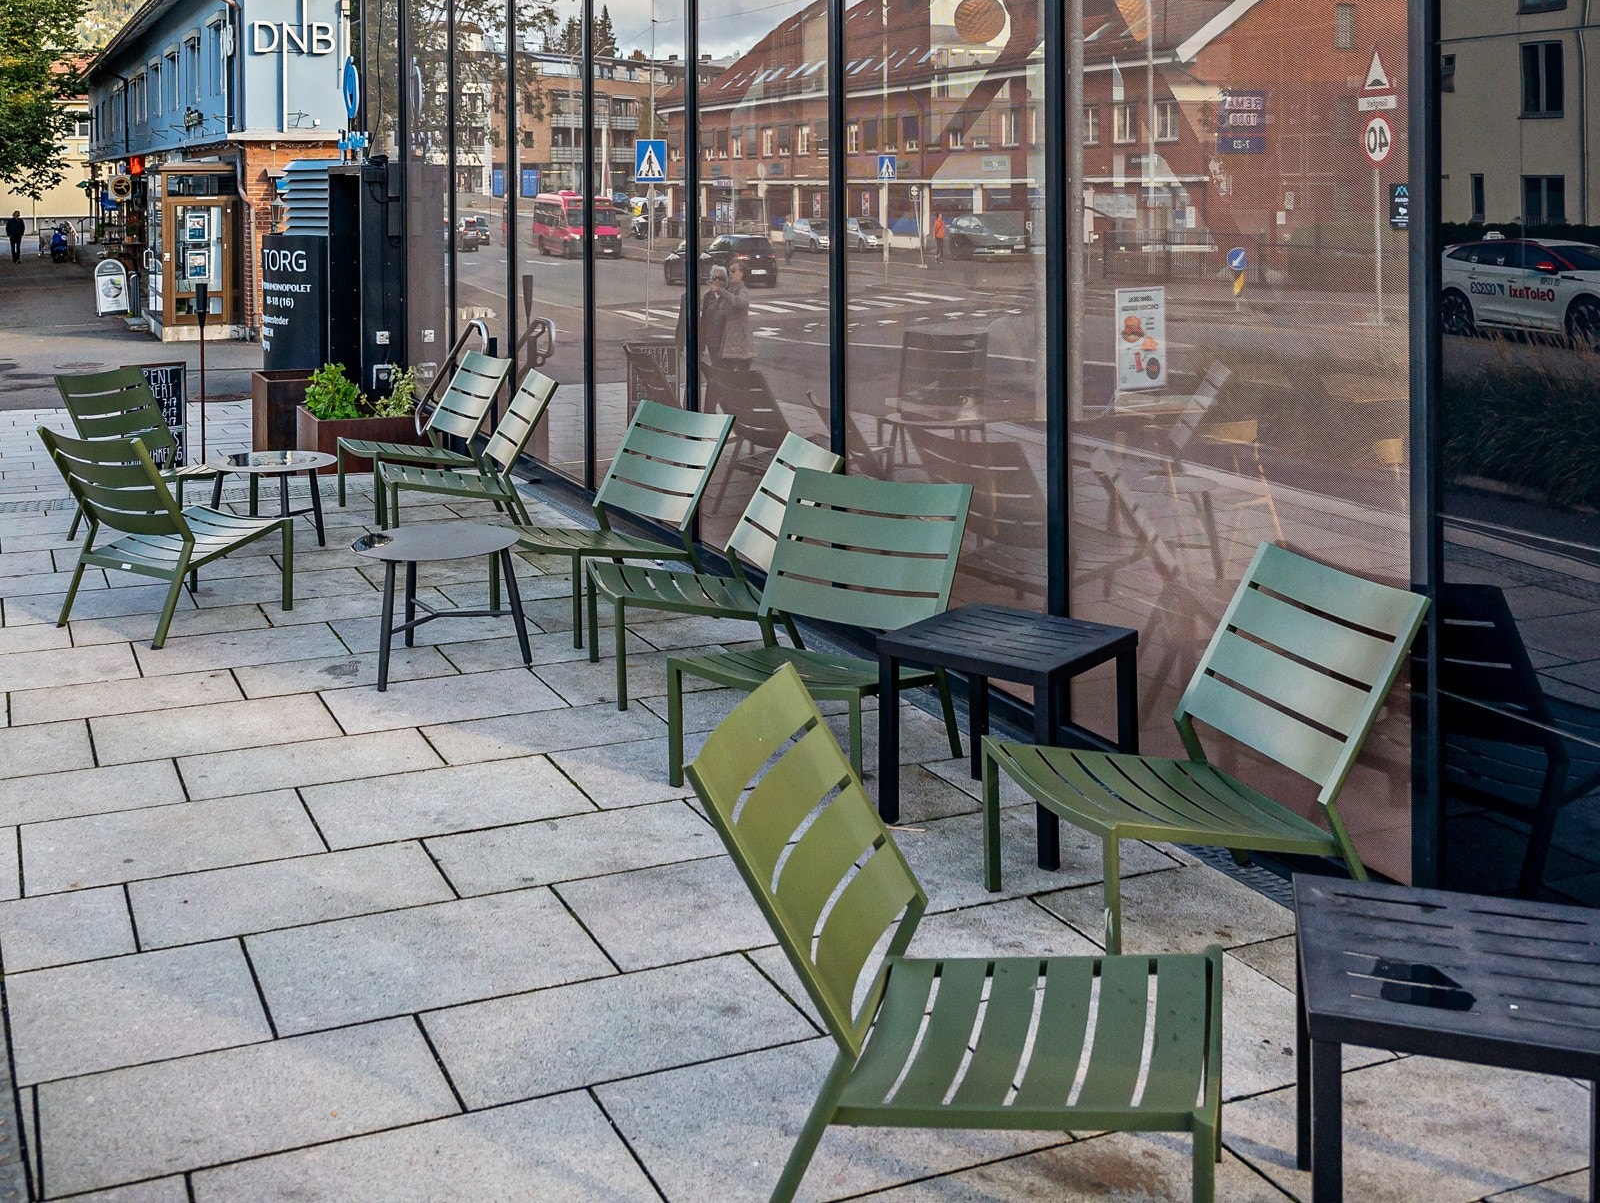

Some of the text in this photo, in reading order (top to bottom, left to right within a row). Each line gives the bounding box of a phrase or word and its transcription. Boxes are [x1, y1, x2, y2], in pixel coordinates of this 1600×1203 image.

[253, 20, 336, 54] DNB
[263, 249, 307, 272] TORG
[279, 297, 295, 309] (16)
[142, 368, 172, 385] PENT
